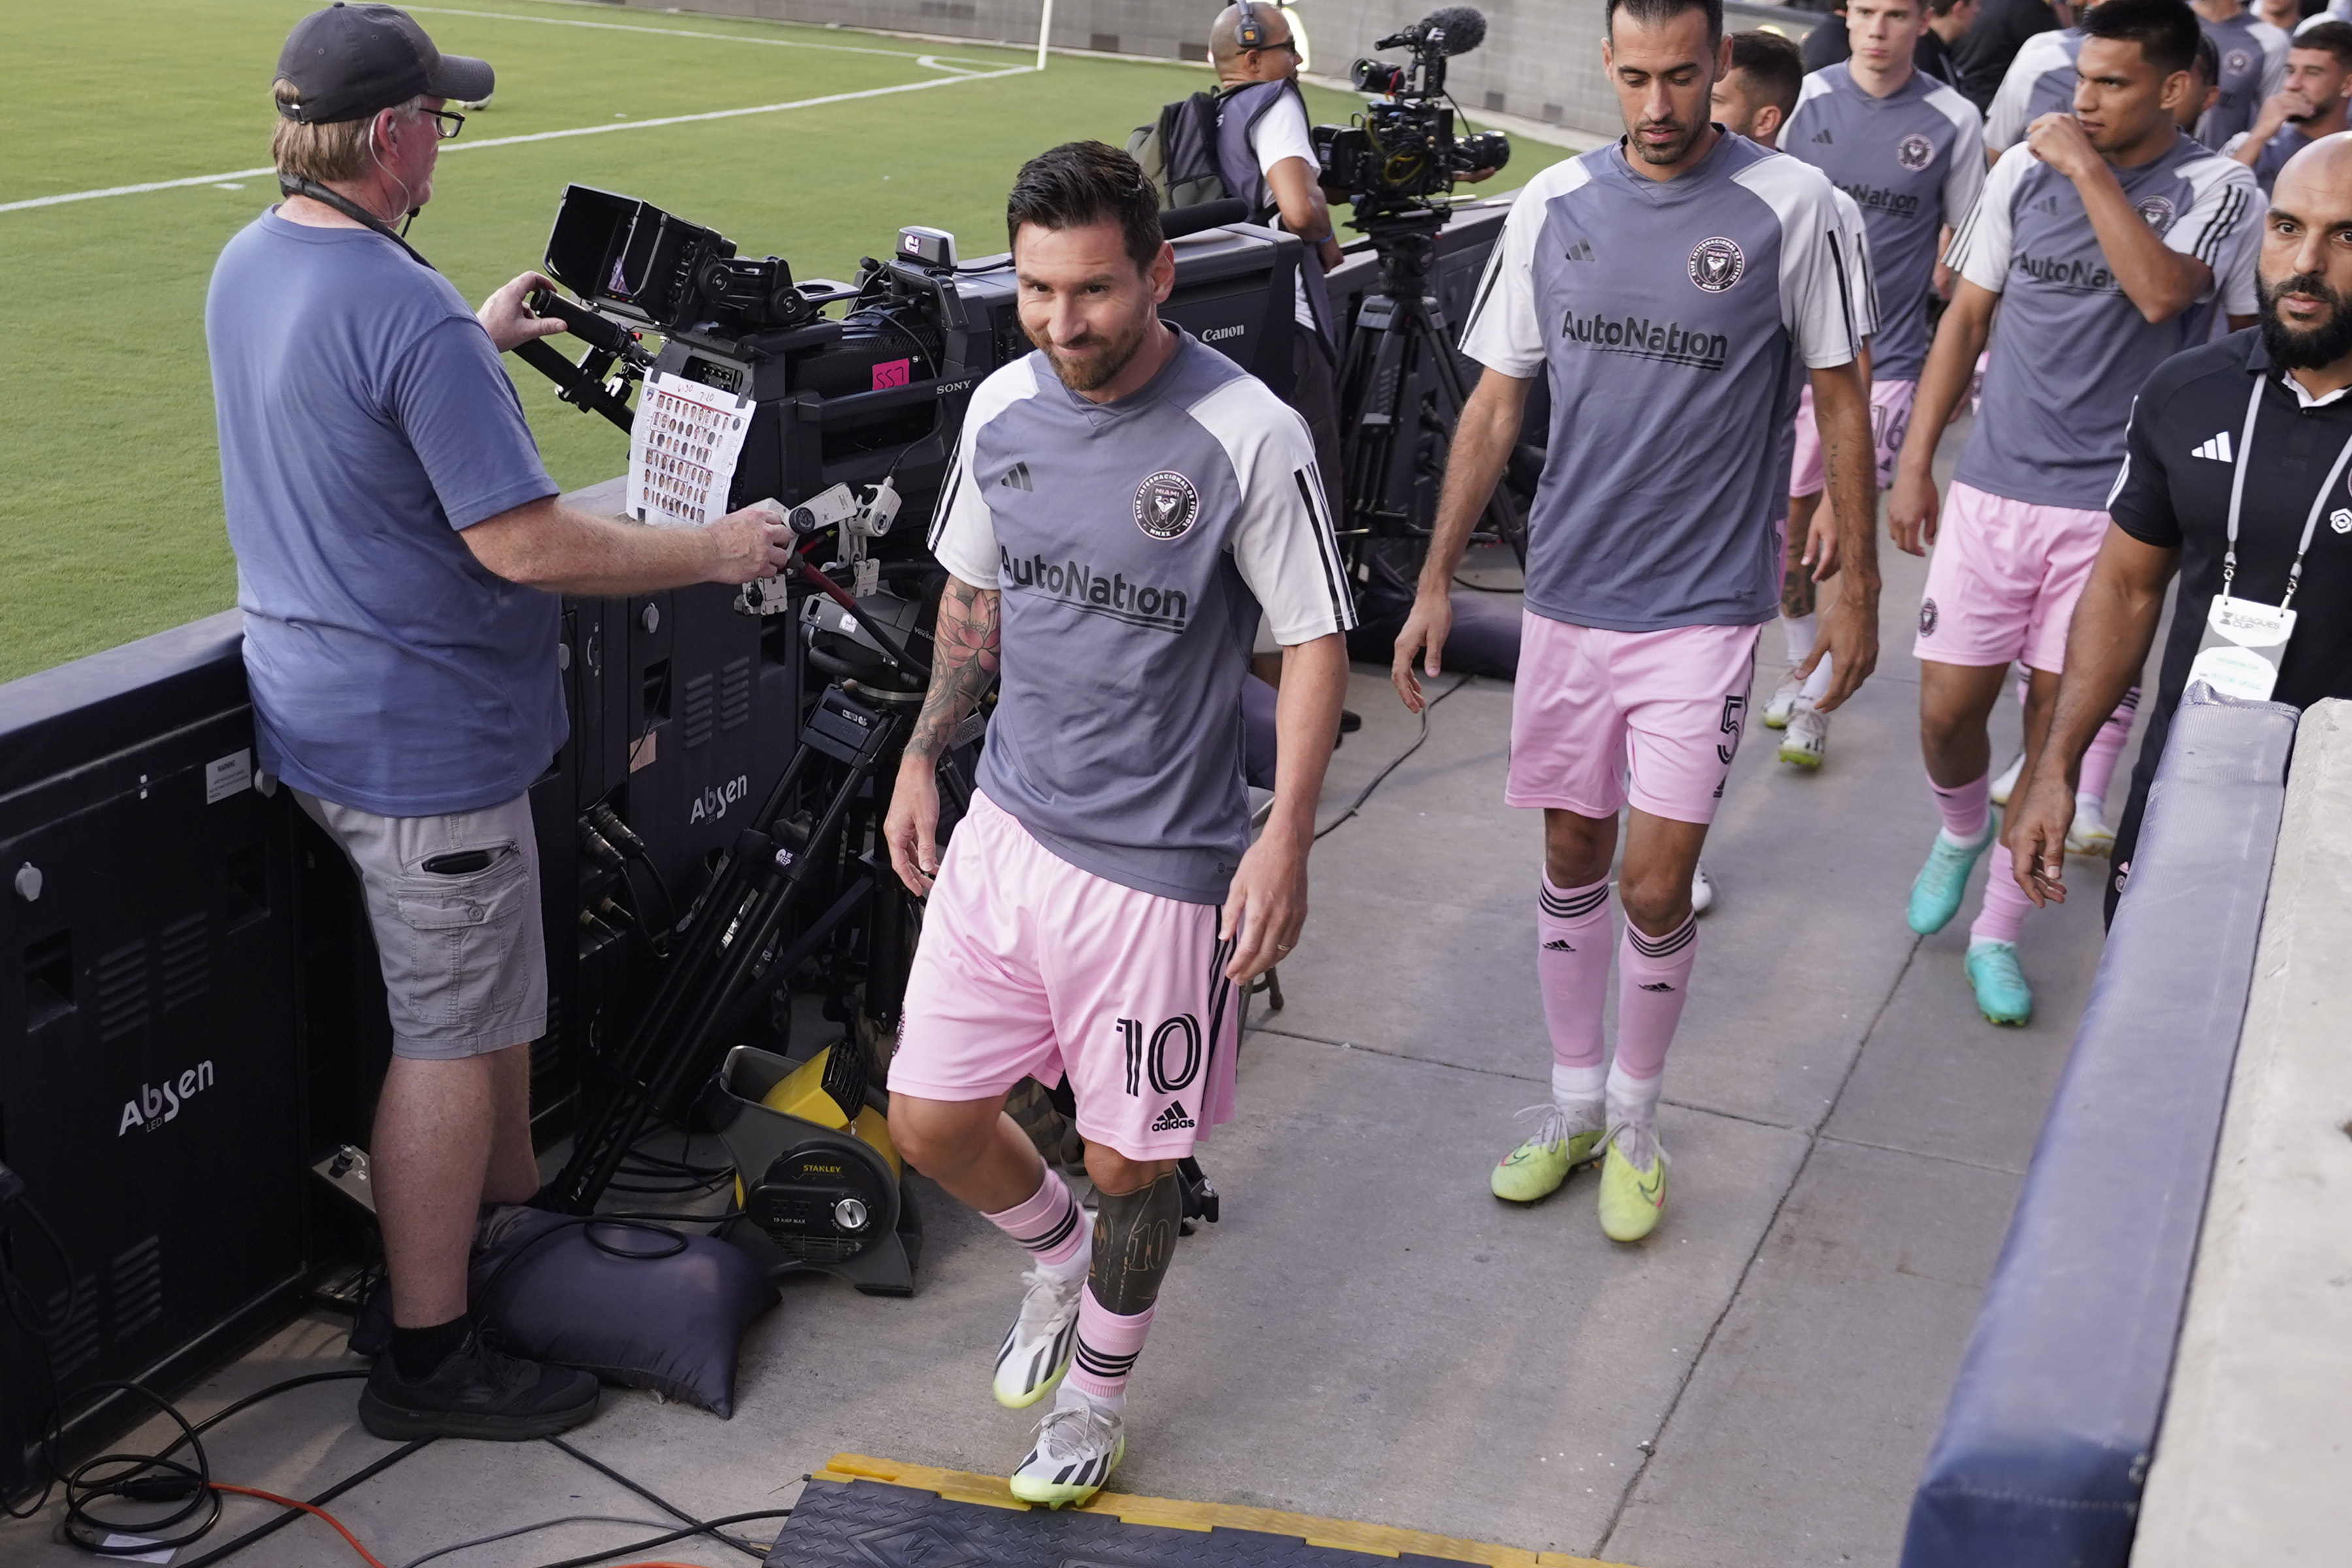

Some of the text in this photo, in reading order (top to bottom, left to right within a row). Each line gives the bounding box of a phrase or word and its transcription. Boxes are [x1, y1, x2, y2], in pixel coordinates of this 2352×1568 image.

[1201, 324, 1245, 342] Canon
[1561, 310, 1728, 359] AutoNation
[912, 352, 937, 363] SOY
[936, 380, 972, 394] SONY
[1155, 488, 1180, 497] MIAMI
[1001, 545, 1187, 619] AutoNation
[2234, 614, 2280, 630] LEAGUES
[915, 626, 935, 642] Vecto
[1717, 695, 1744, 765] 5
[690, 775, 747, 825] Absen
[1116, 1013, 1201, 1097] 10
[118, 1060, 214, 1137] Absen
[146, 1117, 162, 1133] LED
[1151, 1118, 1195, 1132] adidas
[803, 1164, 841, 1173] STANLEY
